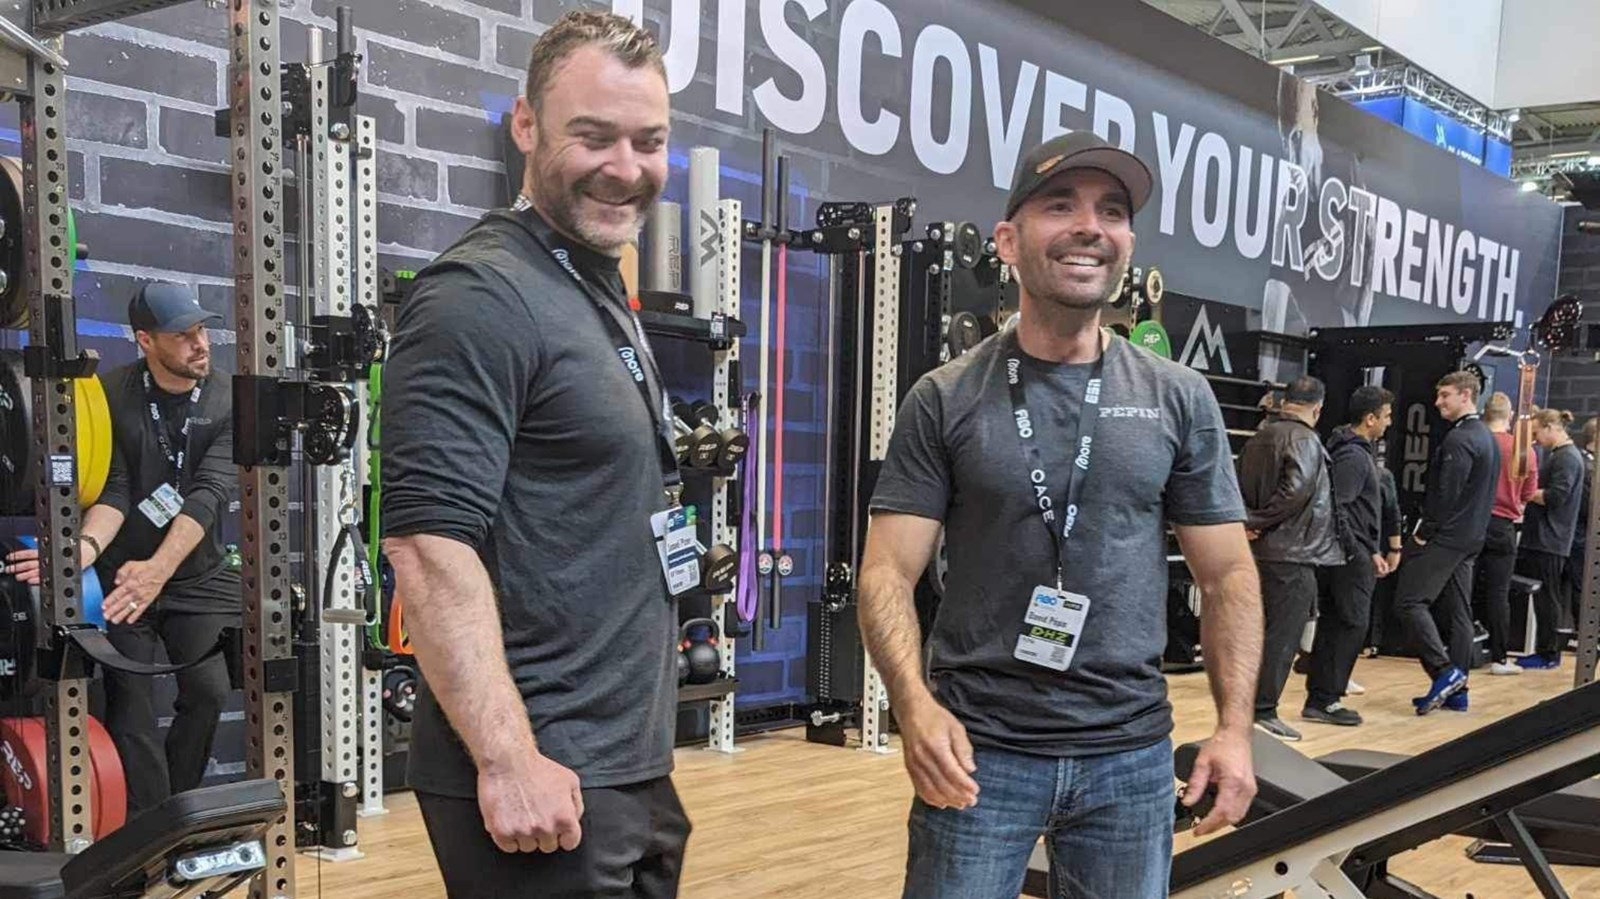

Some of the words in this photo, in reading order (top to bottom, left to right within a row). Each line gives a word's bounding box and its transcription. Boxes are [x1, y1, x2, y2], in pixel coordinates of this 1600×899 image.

[1152, 111, 1308, 272] YOUR
[1314, 177, 1523, 327] STRENGTH.
[668, 234, 680, 290] REP
[1014, 408, 1034, 438] FIBO
[1402, 403, 1431, 492] REP
[1030, 468, 1056, 523] OACE
[360, 558, 373, 585] REP
[1030, 625, 1069, 643] DHZ
